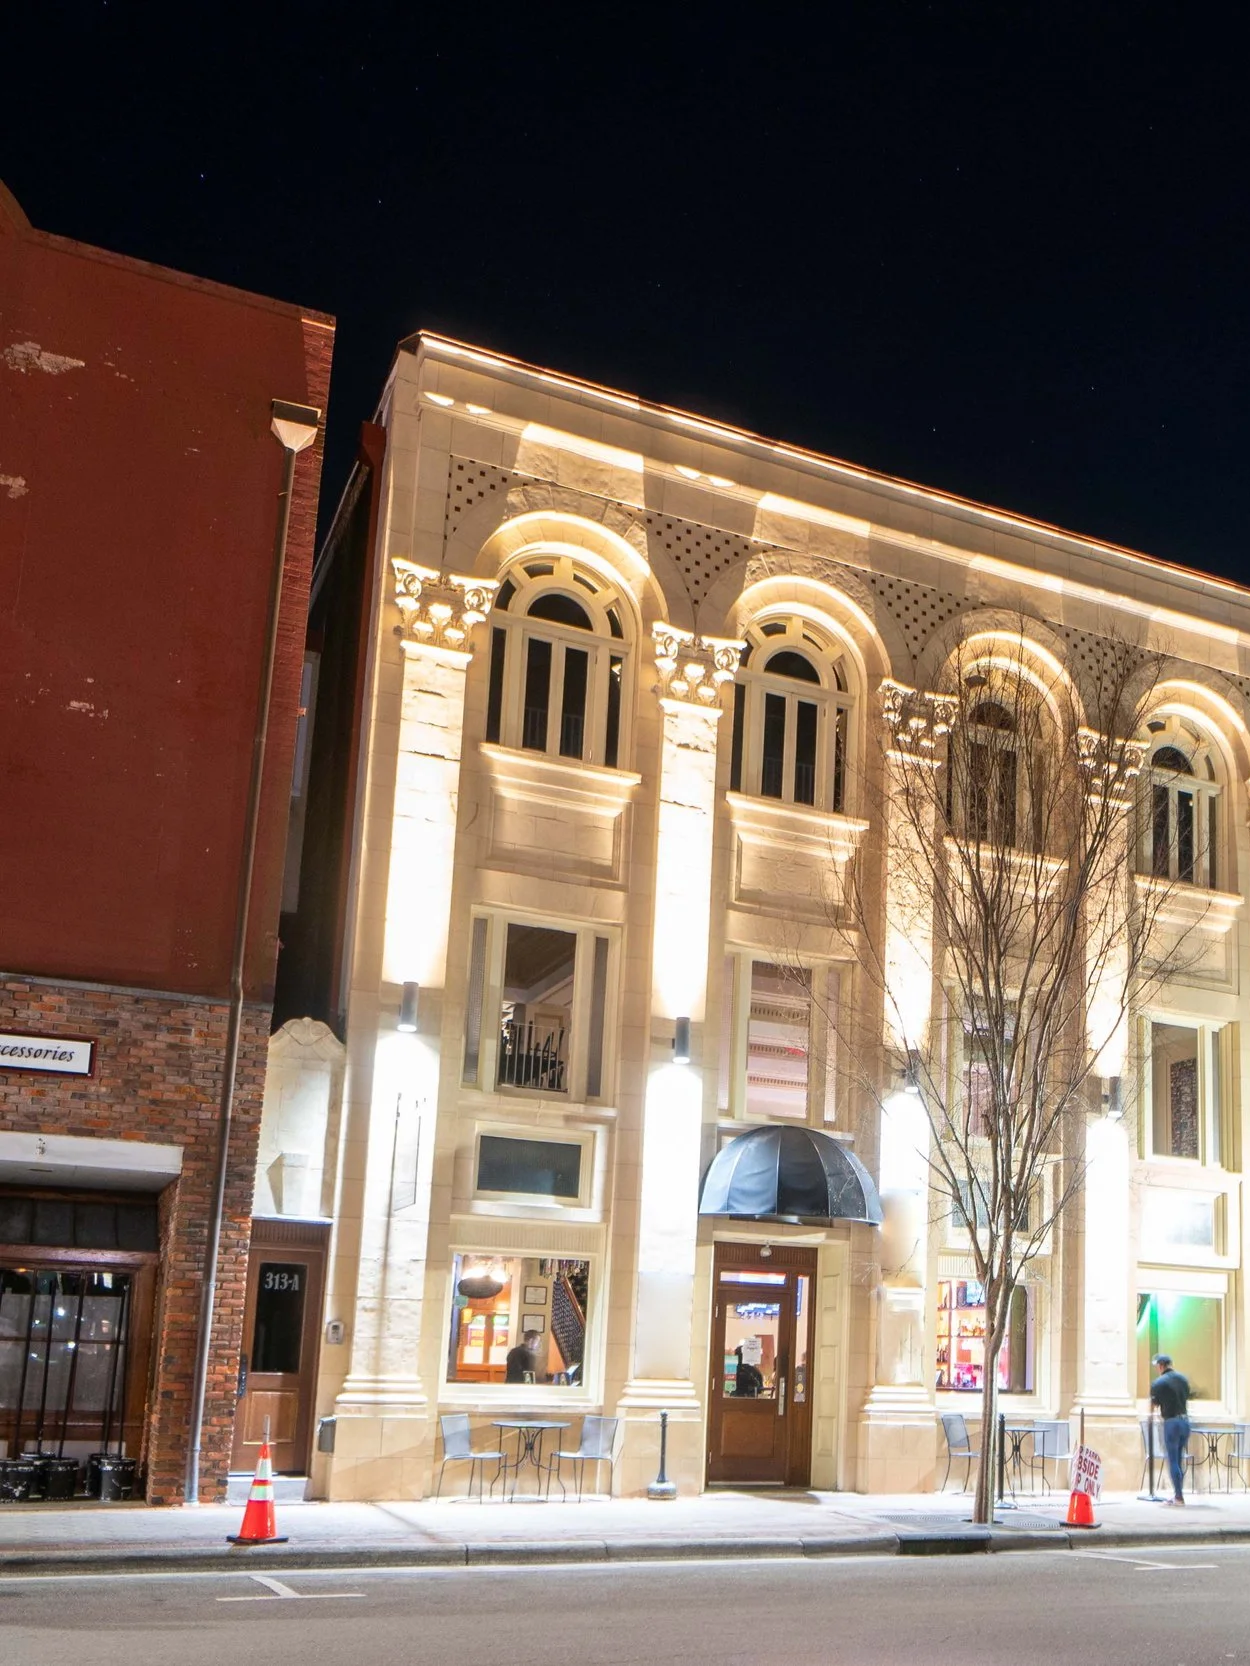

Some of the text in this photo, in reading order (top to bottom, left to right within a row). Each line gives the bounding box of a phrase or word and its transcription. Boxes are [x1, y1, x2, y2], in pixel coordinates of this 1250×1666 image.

[0, 1045, 75, 1062] cessories
[264, 1271, 299, 1291] 313-A
[1077, 1455, 1099, 1480] BSIDE
[1084, 1477, 1101, 1499] ONLY
